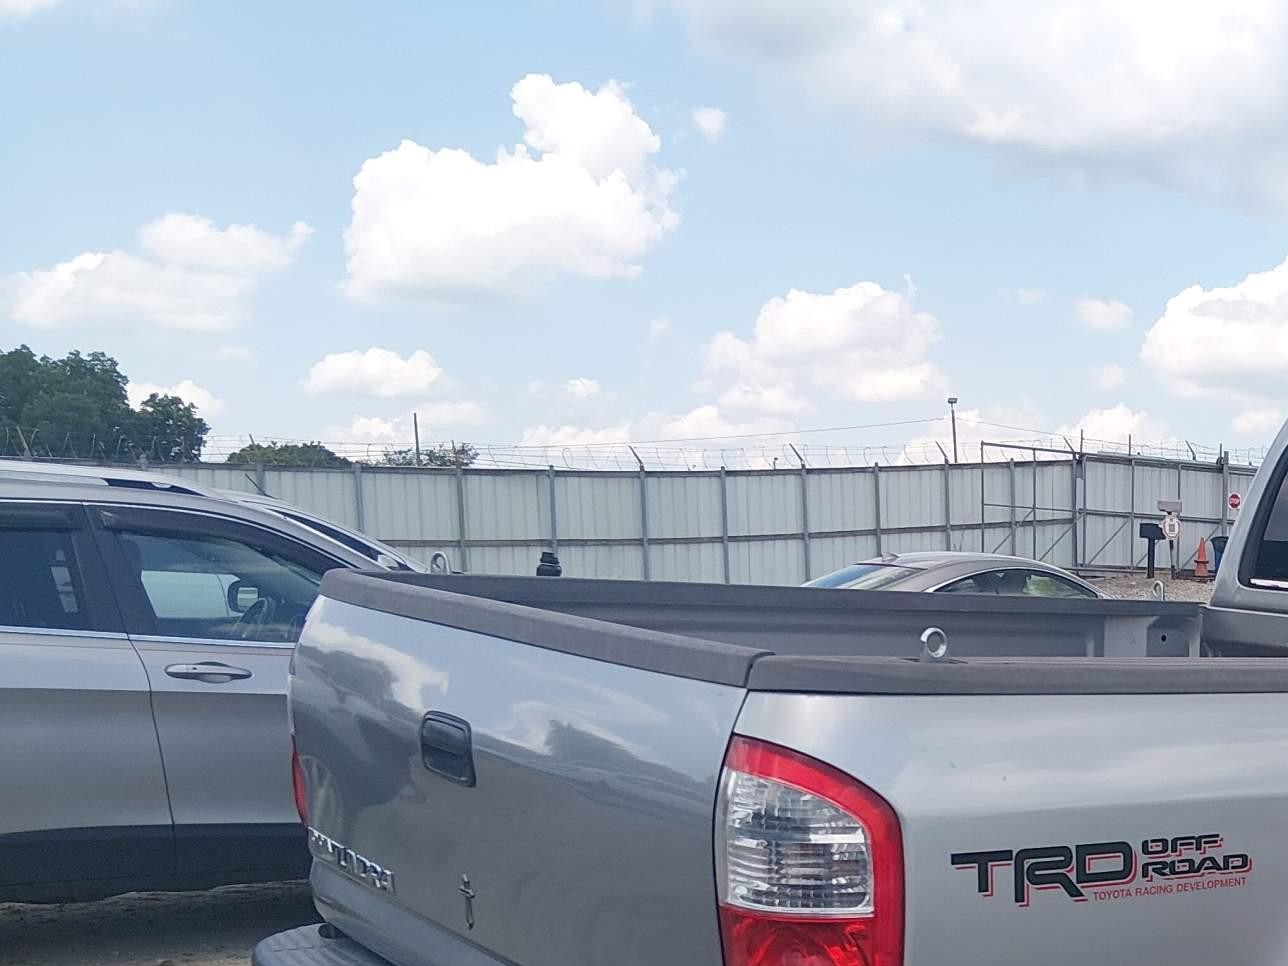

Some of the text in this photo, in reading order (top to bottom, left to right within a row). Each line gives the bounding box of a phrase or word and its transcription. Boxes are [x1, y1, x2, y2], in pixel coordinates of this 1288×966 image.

[1142, 834, 1224, 858] OFF
[951, 841, 1136, 907] TRD
[1142, 853, 1252, 882] ROAD
[1093, 877, 1247, 901] TOYOTA RACING DEVELOPMENT
